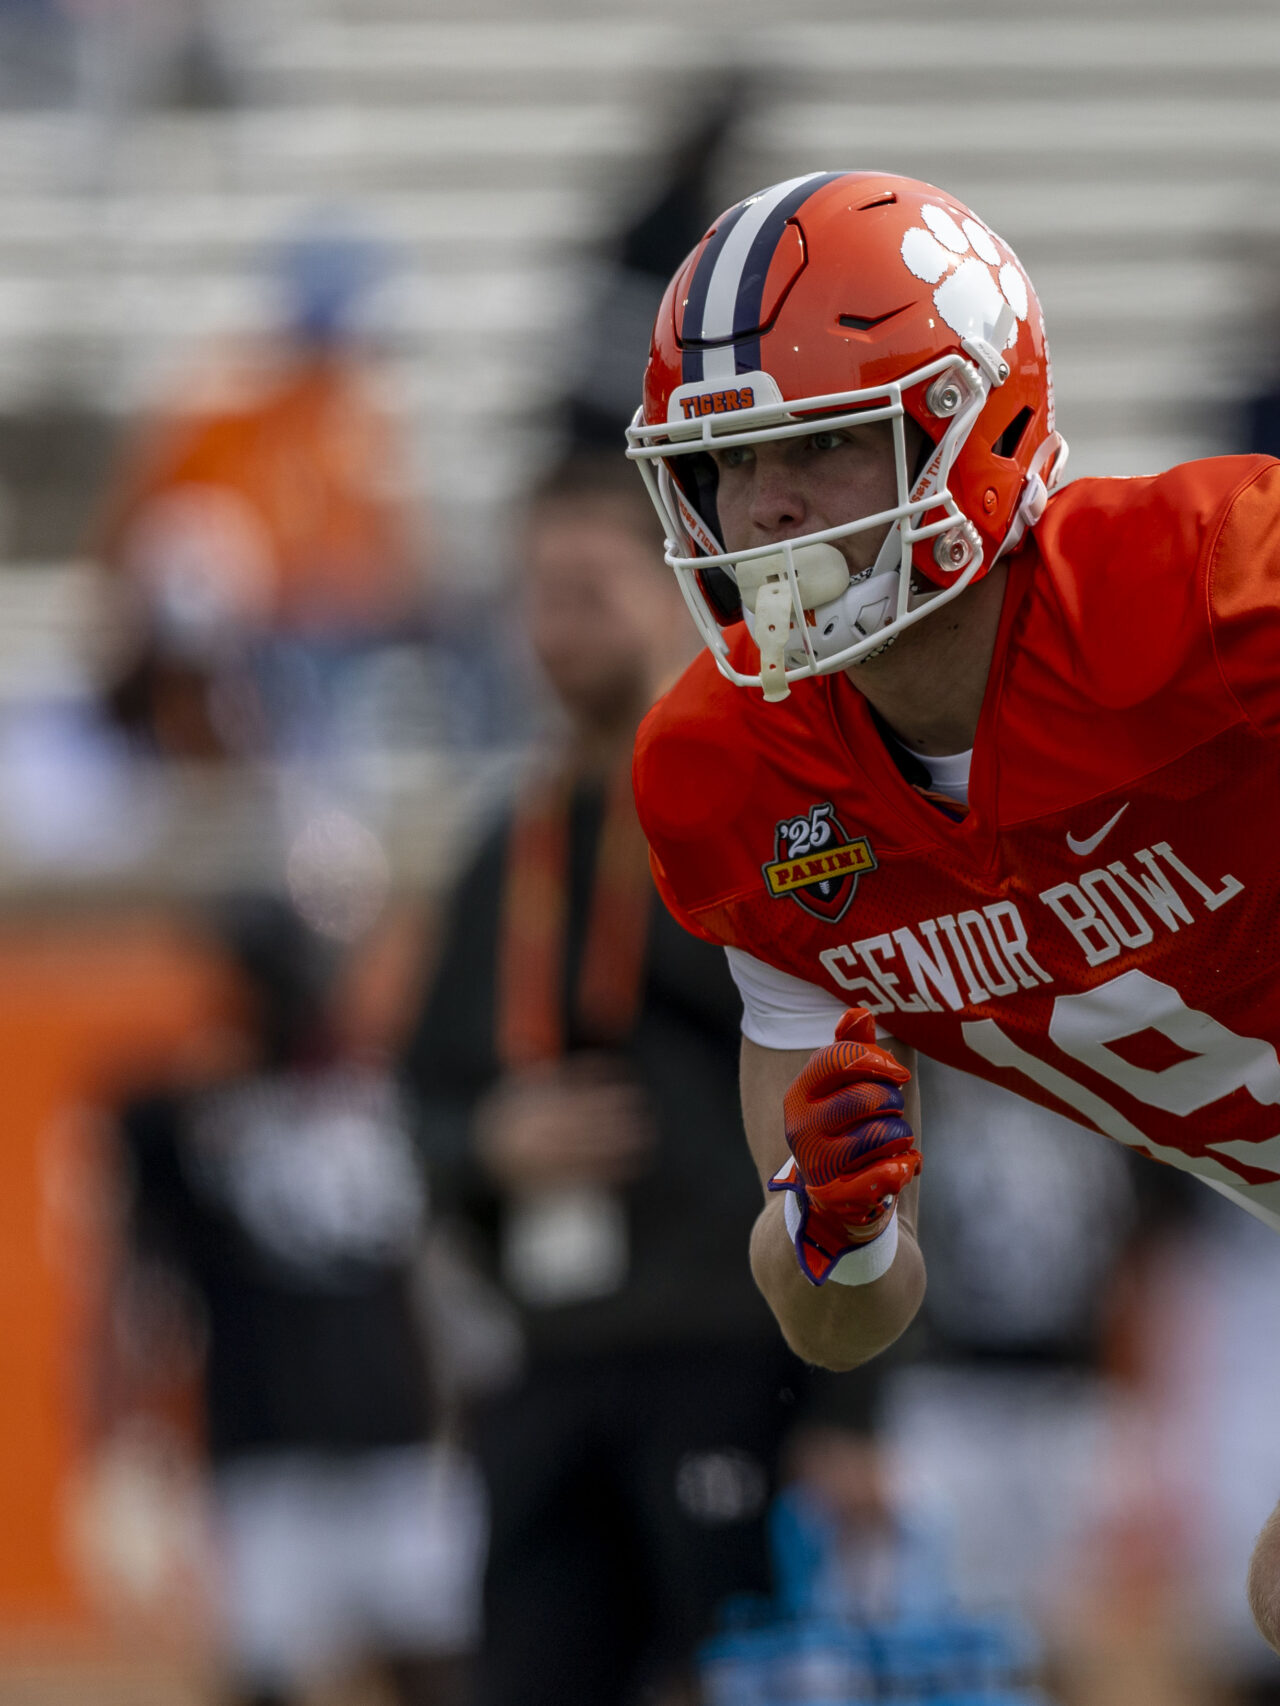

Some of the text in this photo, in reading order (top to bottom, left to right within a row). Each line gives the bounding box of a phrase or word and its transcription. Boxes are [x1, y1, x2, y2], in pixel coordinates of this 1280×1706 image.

[680, 387, 755, 419] TIGERS
[780, 806, 831, 859] '25
[775, 848, 866, 886] PANINI
[818, 841, 1245, 1015] SENIOR BOWL
